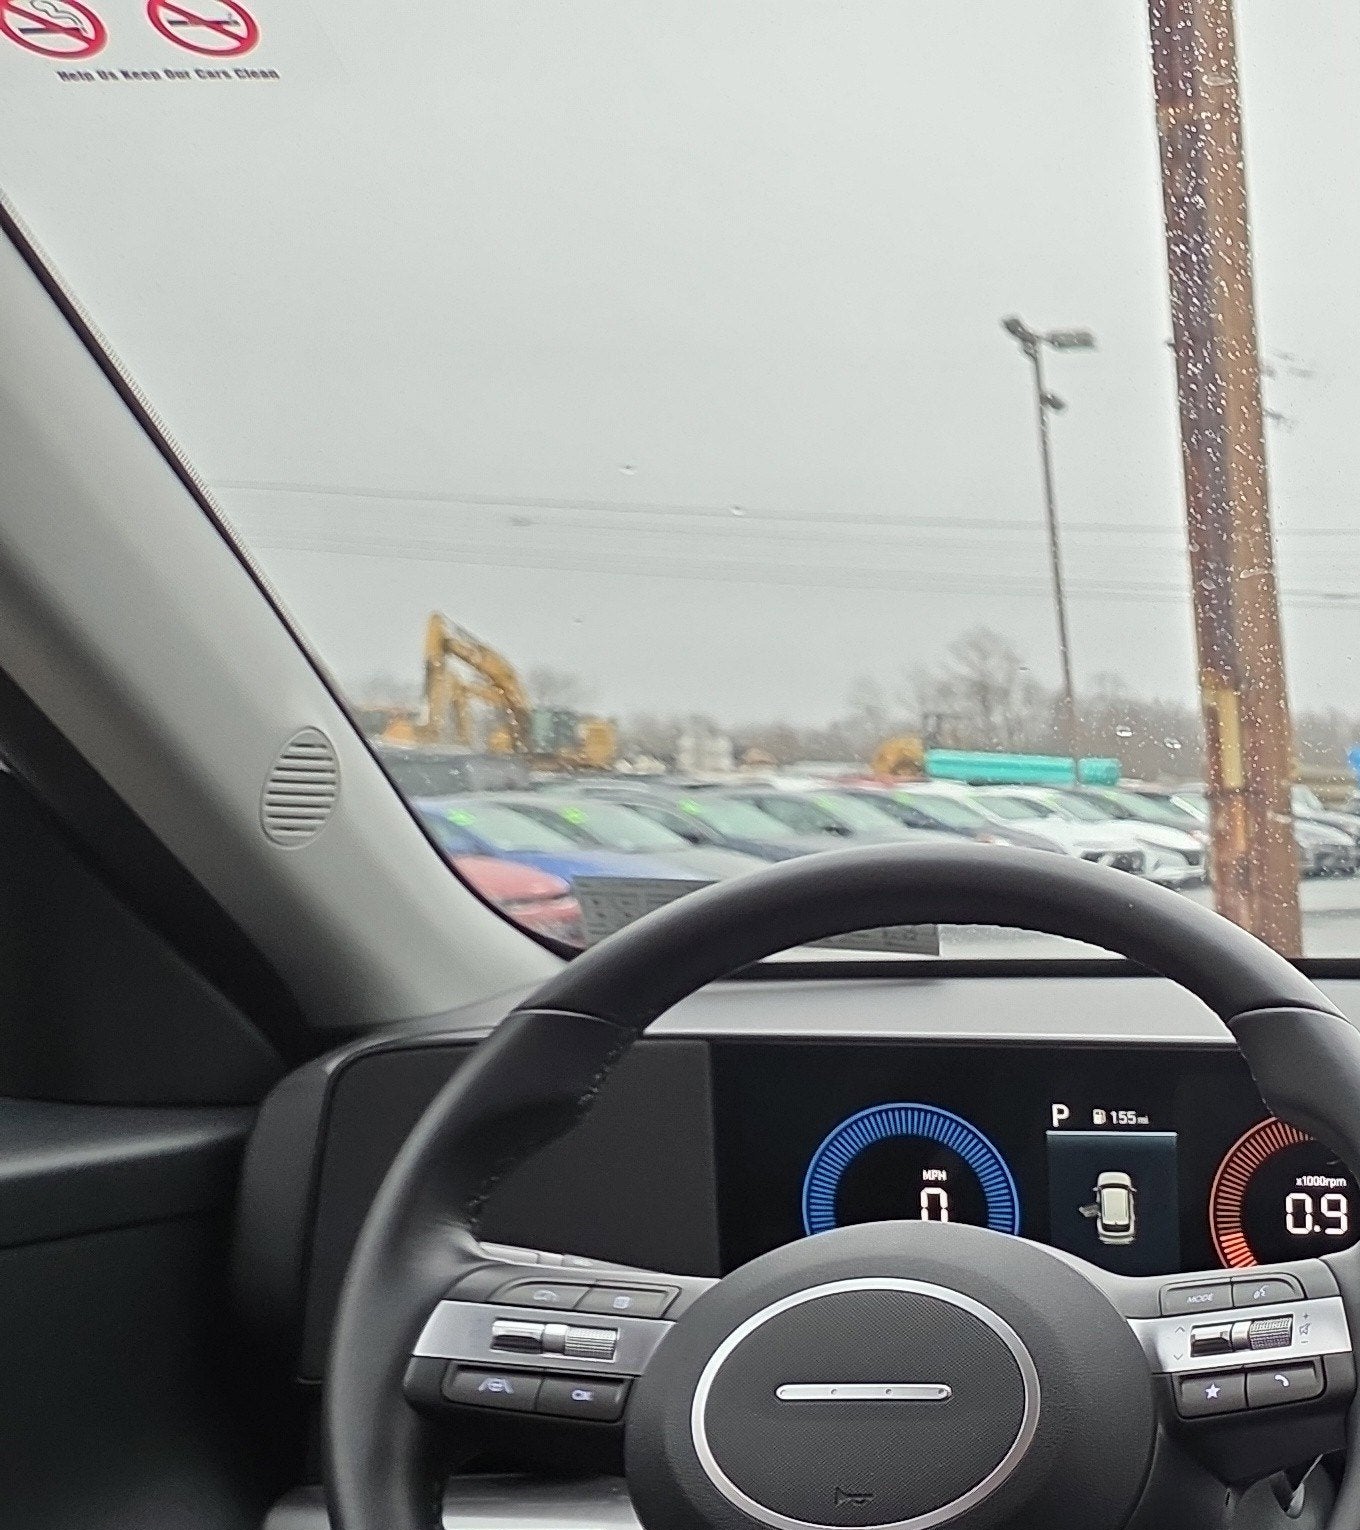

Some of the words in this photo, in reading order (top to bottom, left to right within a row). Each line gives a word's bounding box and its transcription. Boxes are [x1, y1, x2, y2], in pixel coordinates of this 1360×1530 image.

[57, 69, 96, 83] Help
[96, 69, 119, 82] Us
[119, 69, 163, 82] Keep
[163, 68, 192, 80] Our
[193, 68, 233, 80] Cars
[233, 67, 281, 80] Clean
[1052, 1103, 1070, 1128] P
[922, 1169, 948, 1181] MPH
[920, 1187, 949, 1222] 0
[1285, 1193, 1348, 1235] 0.9
[1186, 1292, 1214, 1303] MODE
